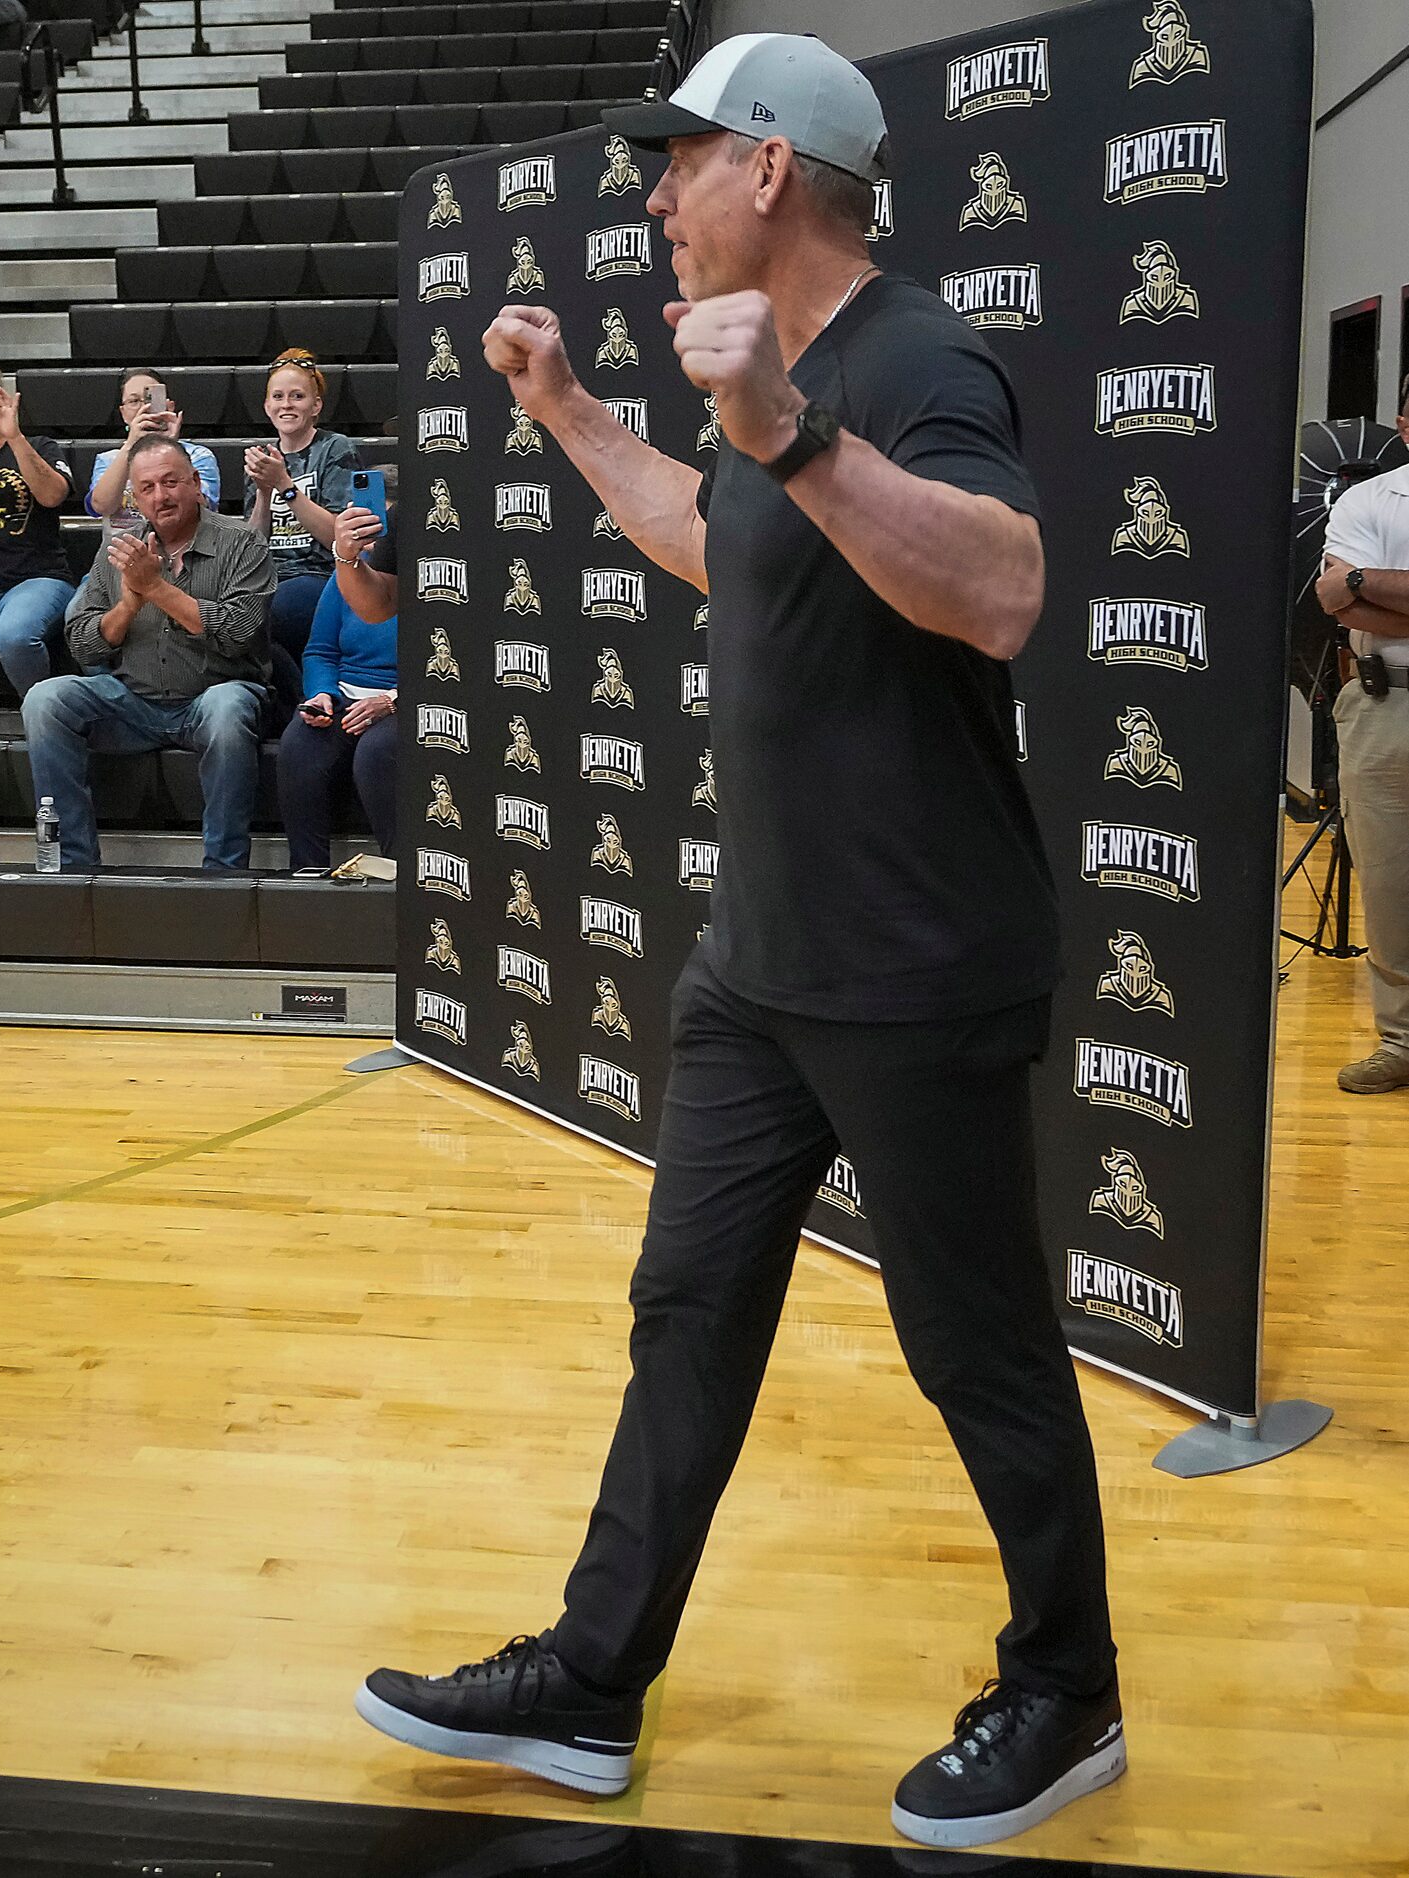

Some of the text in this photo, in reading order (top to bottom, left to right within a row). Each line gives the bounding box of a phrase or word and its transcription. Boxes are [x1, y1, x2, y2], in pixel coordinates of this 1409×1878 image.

[949, 42, 1047, 111] HENRYETTA
[965, 91, 1027, 112] HIGH SCHOOL
[1108, 124, 1223, 194] HENRYETTA
[500, 158, 554, 204] HENRYETTA
[1128, 175, 1200, 195] HIGH SCHOOL
[588, 226, 650, 272] HENRYETTA
[420, 255, 469, 294] HENRYETTA
[944, 268, 1038, 316] HENRYETTA
[984, 313, 1019, 323] SCHOOL
[1099, 369, 1212, 425] HENRYETTA
[419, 409, 467, 444] HENRYETTA
[602, 401, 647, 440] YETTA
[1118, 415, 1190, 429] HIGH SCHOOL
[497, 486, 550, 523] HENRYETTA
[419, 560, 467, 596] HENRYETTA
[583, 572, 644, 613] HENRYETTA
[1092, 603, 1203, 660] HENRYETTA
[497, 643, 549, 684] HENRYETTA
[1111, 648, 1182, 664] HIGH SCHOOL
[418, 707, 468, 747] HENRYETTA
[582, 738, 642, 783] HENRYETTA
[497, 798, 549, 843] HENRYETTA
[418, 850, 470, 895] HENRYETTA
[682, 842, 720, 879] HENRY
[1085, 825, 1196, 893] HENRYETTA
[1103, 872, 1175, 894] HIGH SCHOOL
[581, 899, 641, 950] HENRYETTA
[499, 948, 549, 998] HENRYETTA
[295, 994, 333, 1003] MAXAM
[416, 991, 466, 1040] HENRYETTA
[580, 1058, 640, 1114] HENRYETTA
[1078, 1042, 1188, 1119] HENRYETTA
[1095, 1090, 1167, 1118] HIGH SCHOOL
[821, 1187, 853, 1209] SCHOOL
[1071, 1254, 1180, 1339] HENRYETTA
[1091, 1300, 1160, 1336] HIGH SCHOOL
